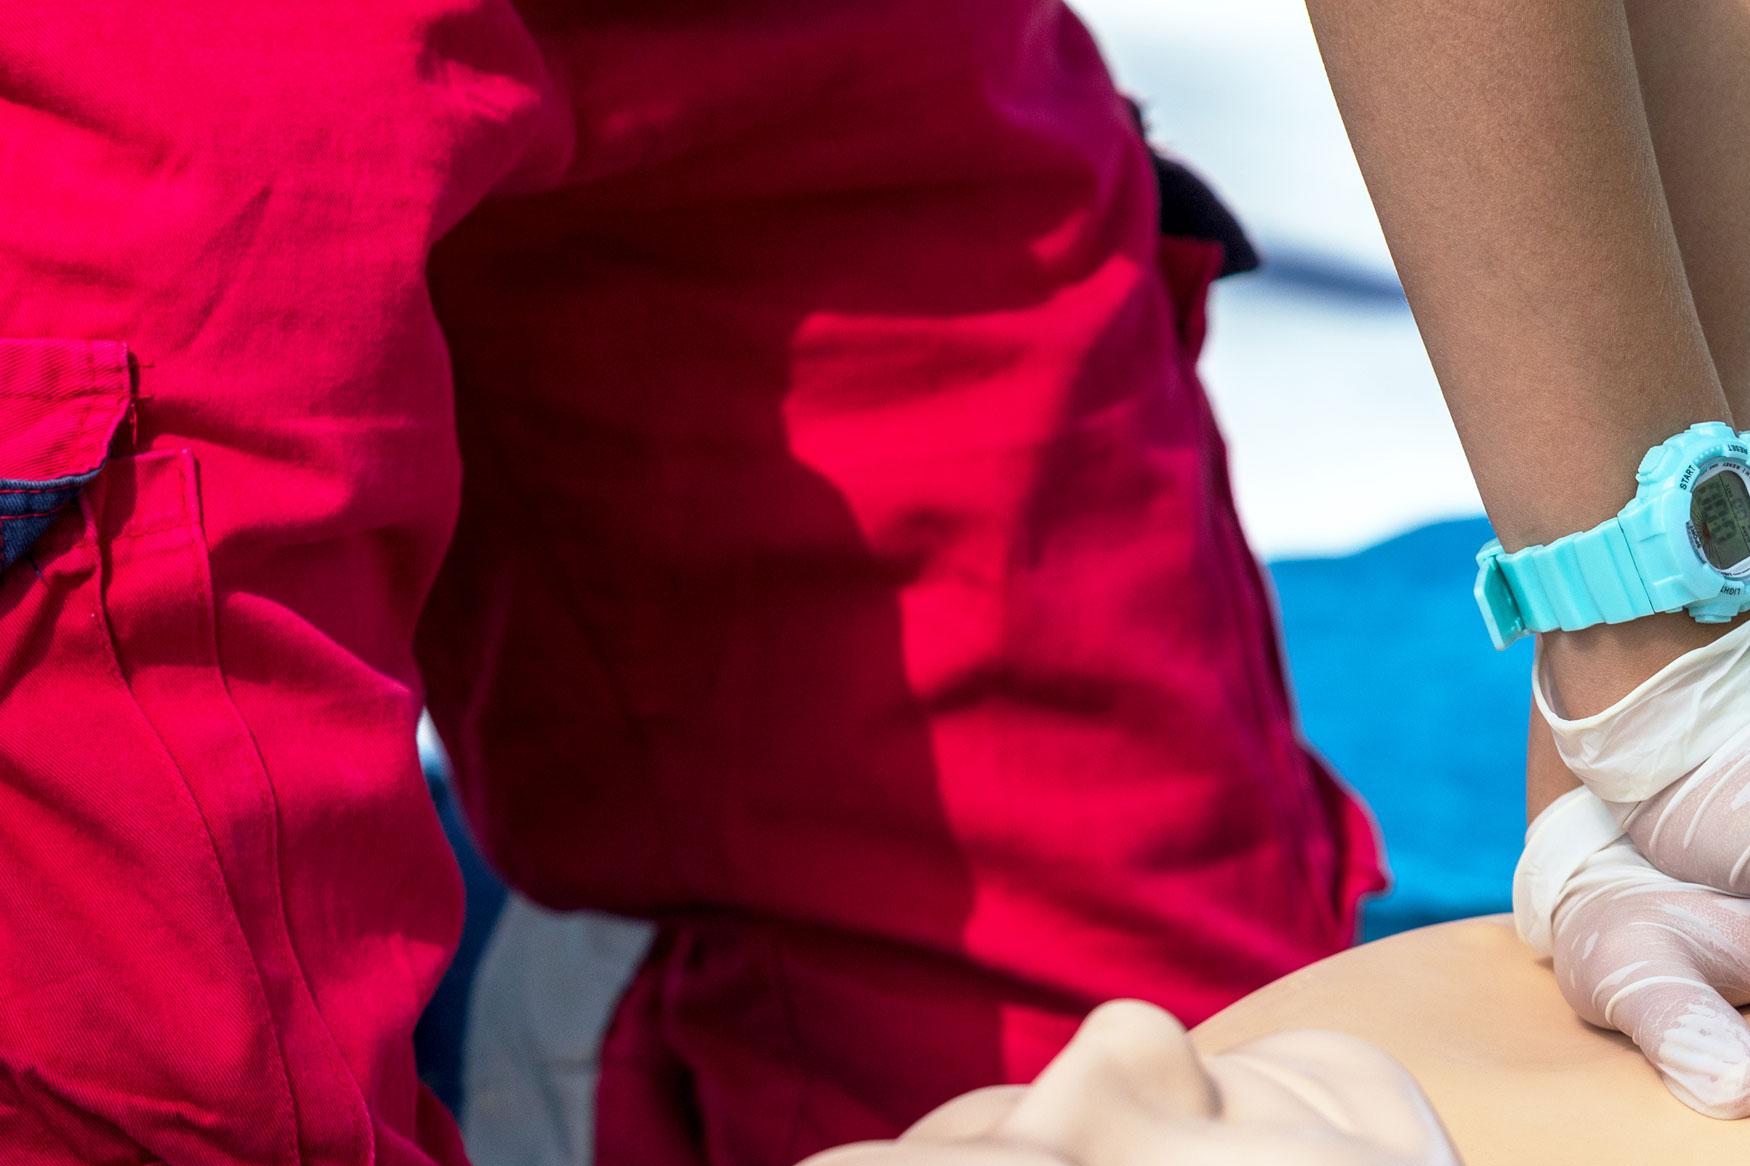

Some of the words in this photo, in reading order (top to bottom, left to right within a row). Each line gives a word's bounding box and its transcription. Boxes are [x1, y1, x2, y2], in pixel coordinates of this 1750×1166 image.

[1728, 444, 1748, 455] RESET
[1680, 465, 1696, 490] START
[1720, 585, 1741, 597] LIGHT
